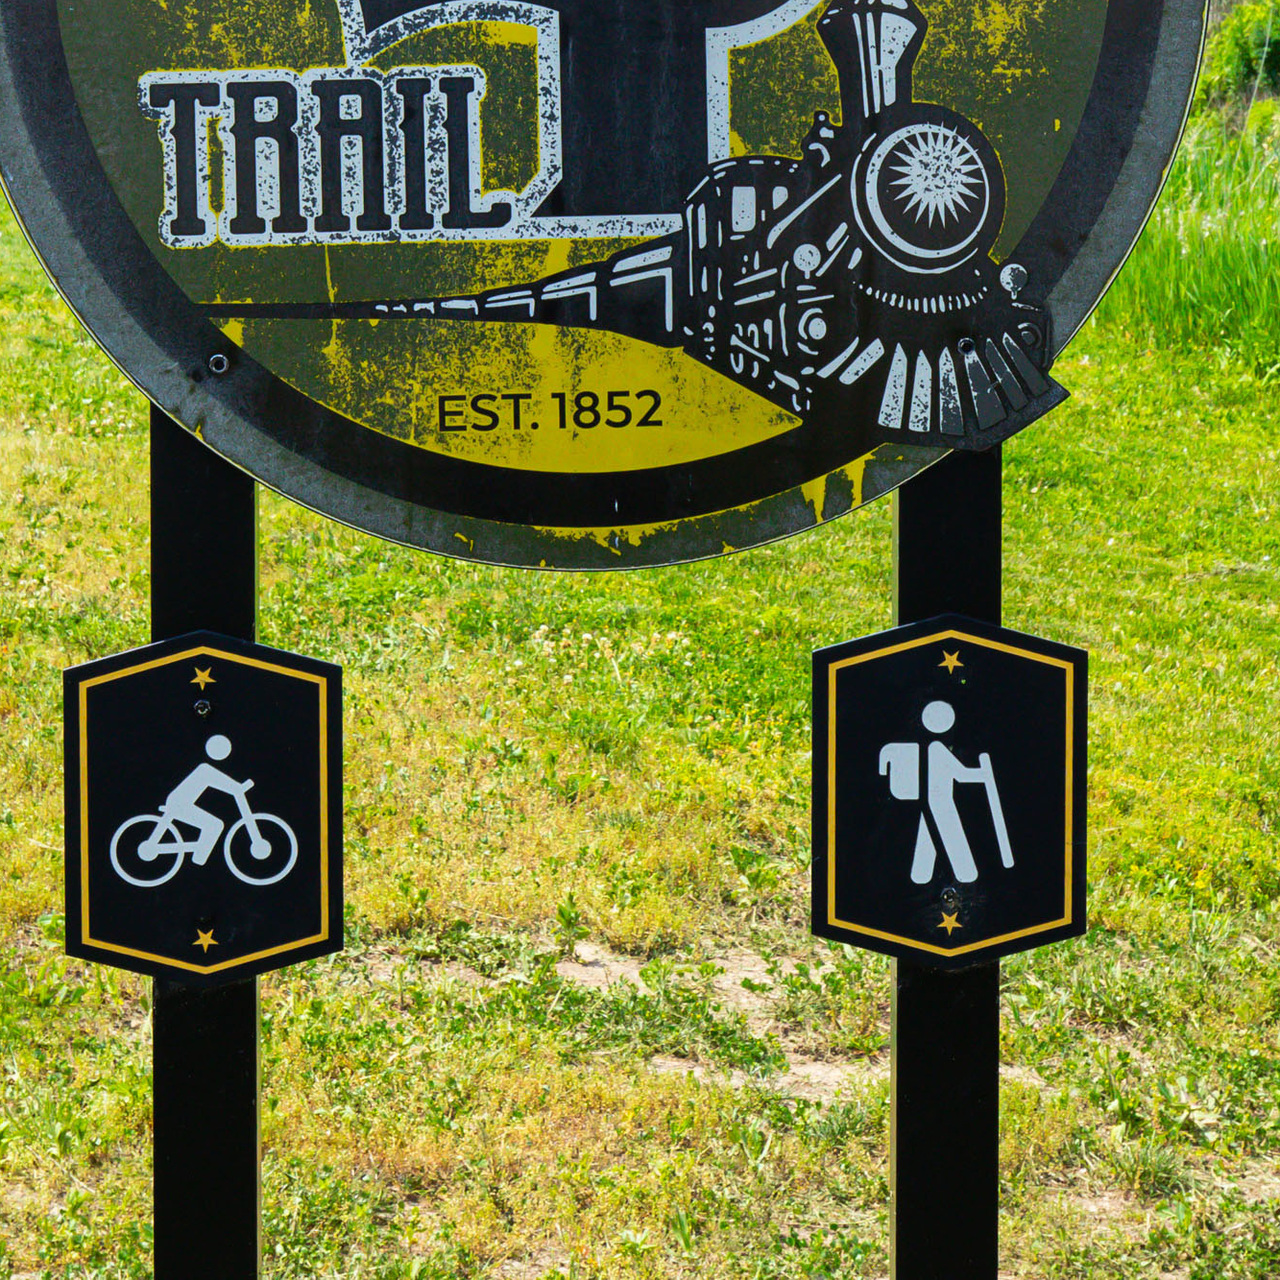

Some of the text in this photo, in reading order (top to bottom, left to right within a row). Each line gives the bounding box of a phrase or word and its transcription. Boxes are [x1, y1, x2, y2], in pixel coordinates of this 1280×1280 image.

[145, 73, 514, 238] TRAIL
[438, 389, 663, 432] EST. 1852
